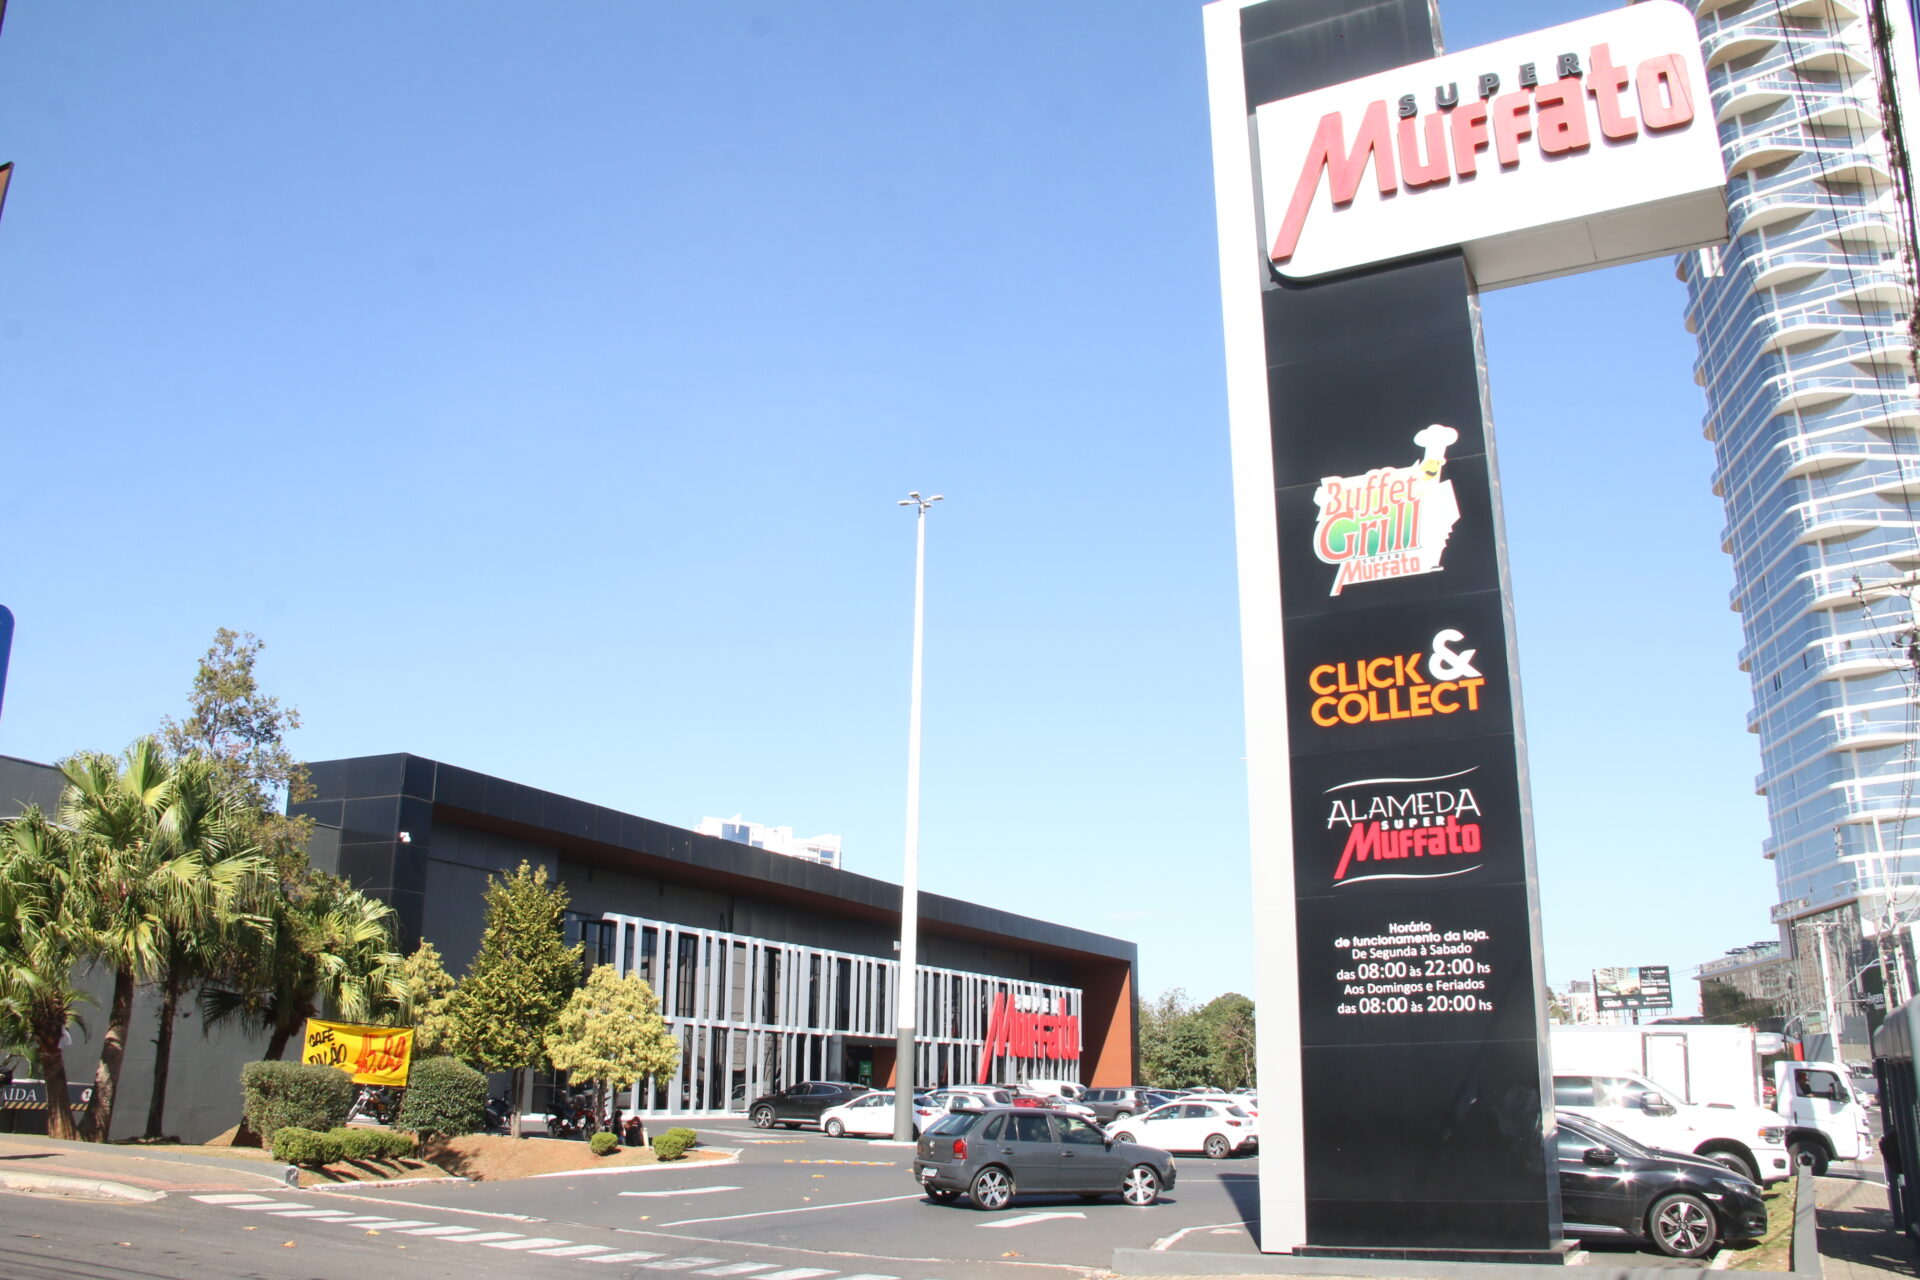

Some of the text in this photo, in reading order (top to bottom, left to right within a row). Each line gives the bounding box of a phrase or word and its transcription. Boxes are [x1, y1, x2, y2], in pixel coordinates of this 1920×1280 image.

[1397, 52, 1584, 119] SUPER
[1271, 42, 1695, 264] Muffato
[1325, 472, 1419, 517] Buffet
[1320, 499, 1421, 560] Grill
[1334, 552, 1420, 595] Muffato
[1362, 553, 1399, 564] SUPER
[1309, 628, 1483, 695] CLICK &
[1311, 677, 1485, 727] COLLECT
[1327, 788, 1481, 830] ALAMEDA
[1380, 816, 1445, 831] SUPER
[1333, 815, 1482, 880] Muffato
[1334, 937, 1350, 948] de
[1352, 932, 1441, 947] funcionamento
[1443, 930, 1461, 942] da
[1388, 921, 1432, 934] Horário
[1336, 958, 1491, 981] das 08:00 às 22:00 hs
[1352, 948, 1367, 960] De
[1369, 946, 1418, 960] Segunda
[1429, 942, 1472, 955] Sabado
[1337, 995, 1493, 1014] das 08:00 às 20:00 hs
[1344, 978, 1485, 996] Aos Domingos e Feriados
